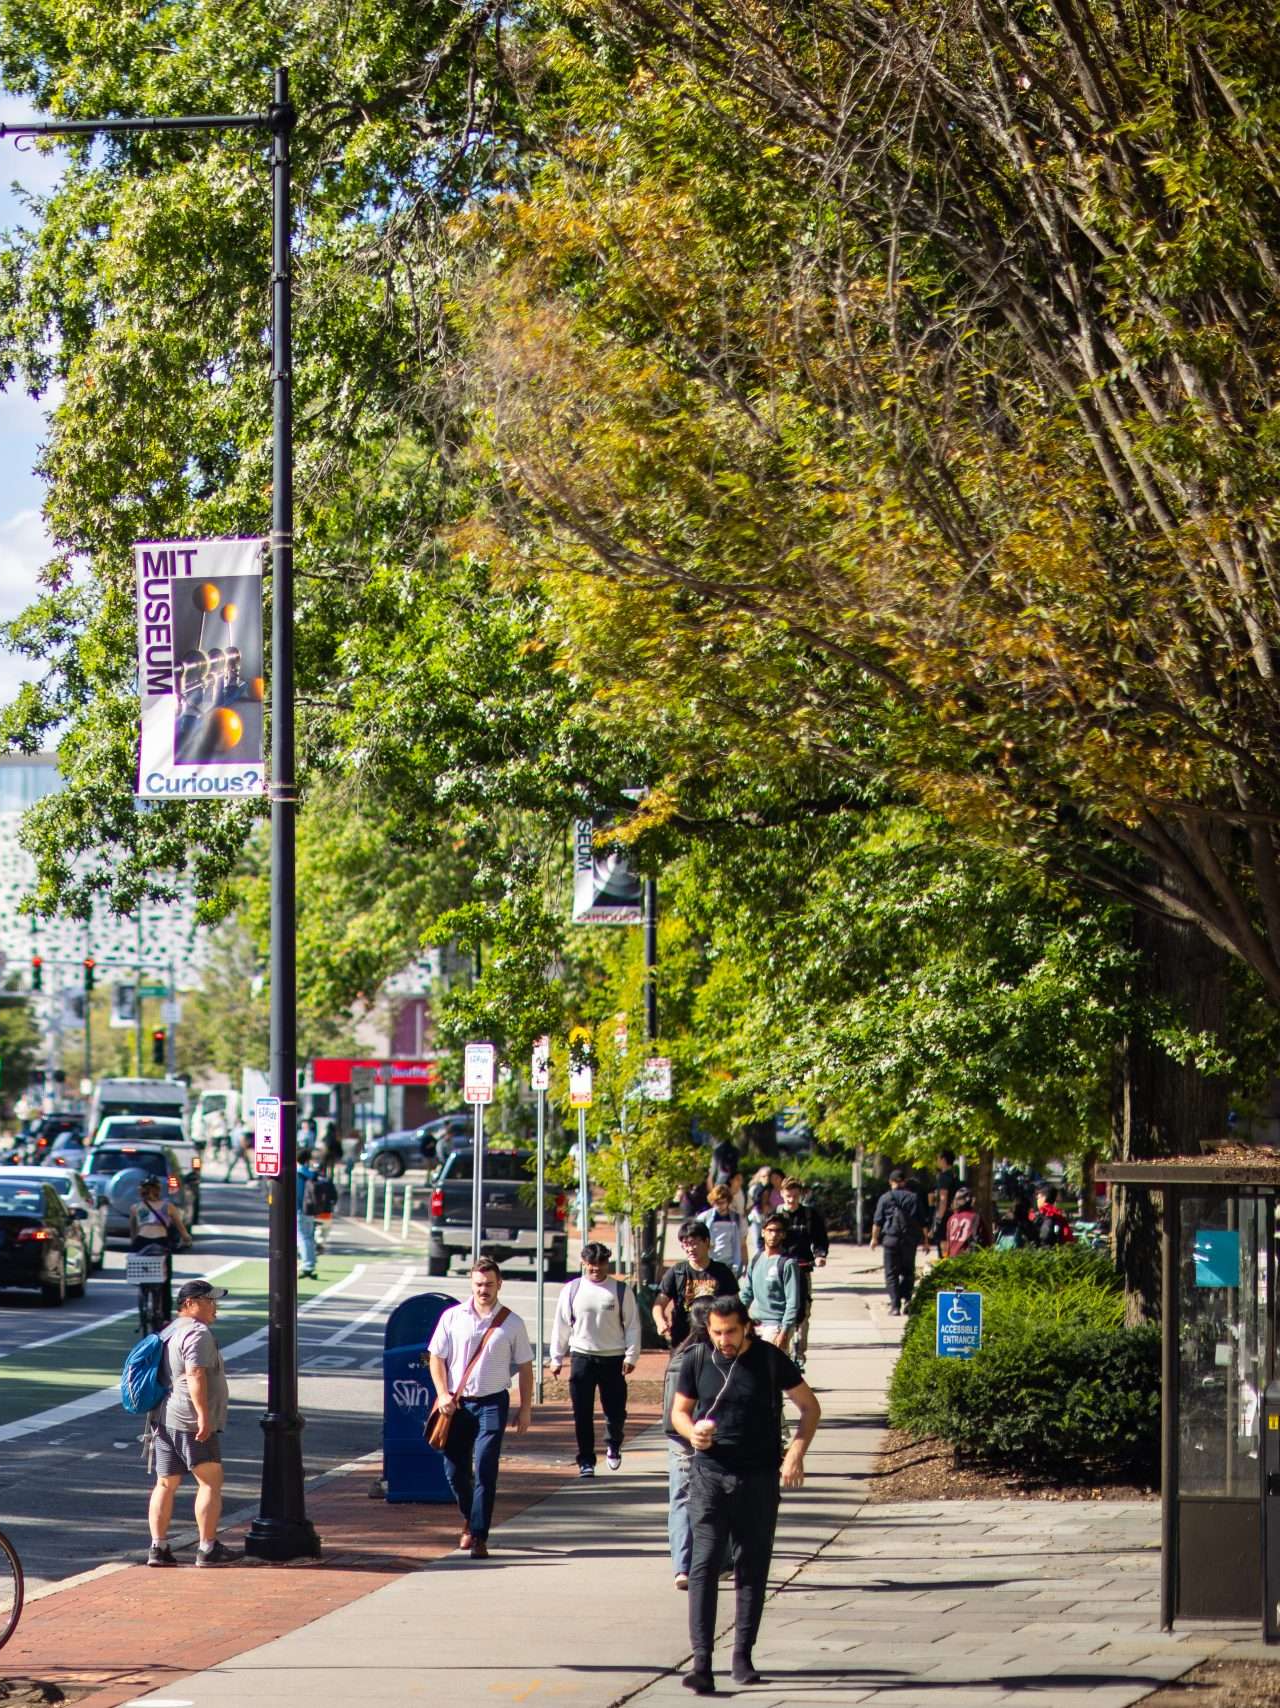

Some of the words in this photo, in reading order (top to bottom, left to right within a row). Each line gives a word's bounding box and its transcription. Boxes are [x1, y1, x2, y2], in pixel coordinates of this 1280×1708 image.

[142, 549, 197, 577] MIT
[145, 771, 259, 793] Curious?
[940, 1324, 978, 1334] ACCESSIBLE
[943, 1335, 976, 1345] ENTRANCE
